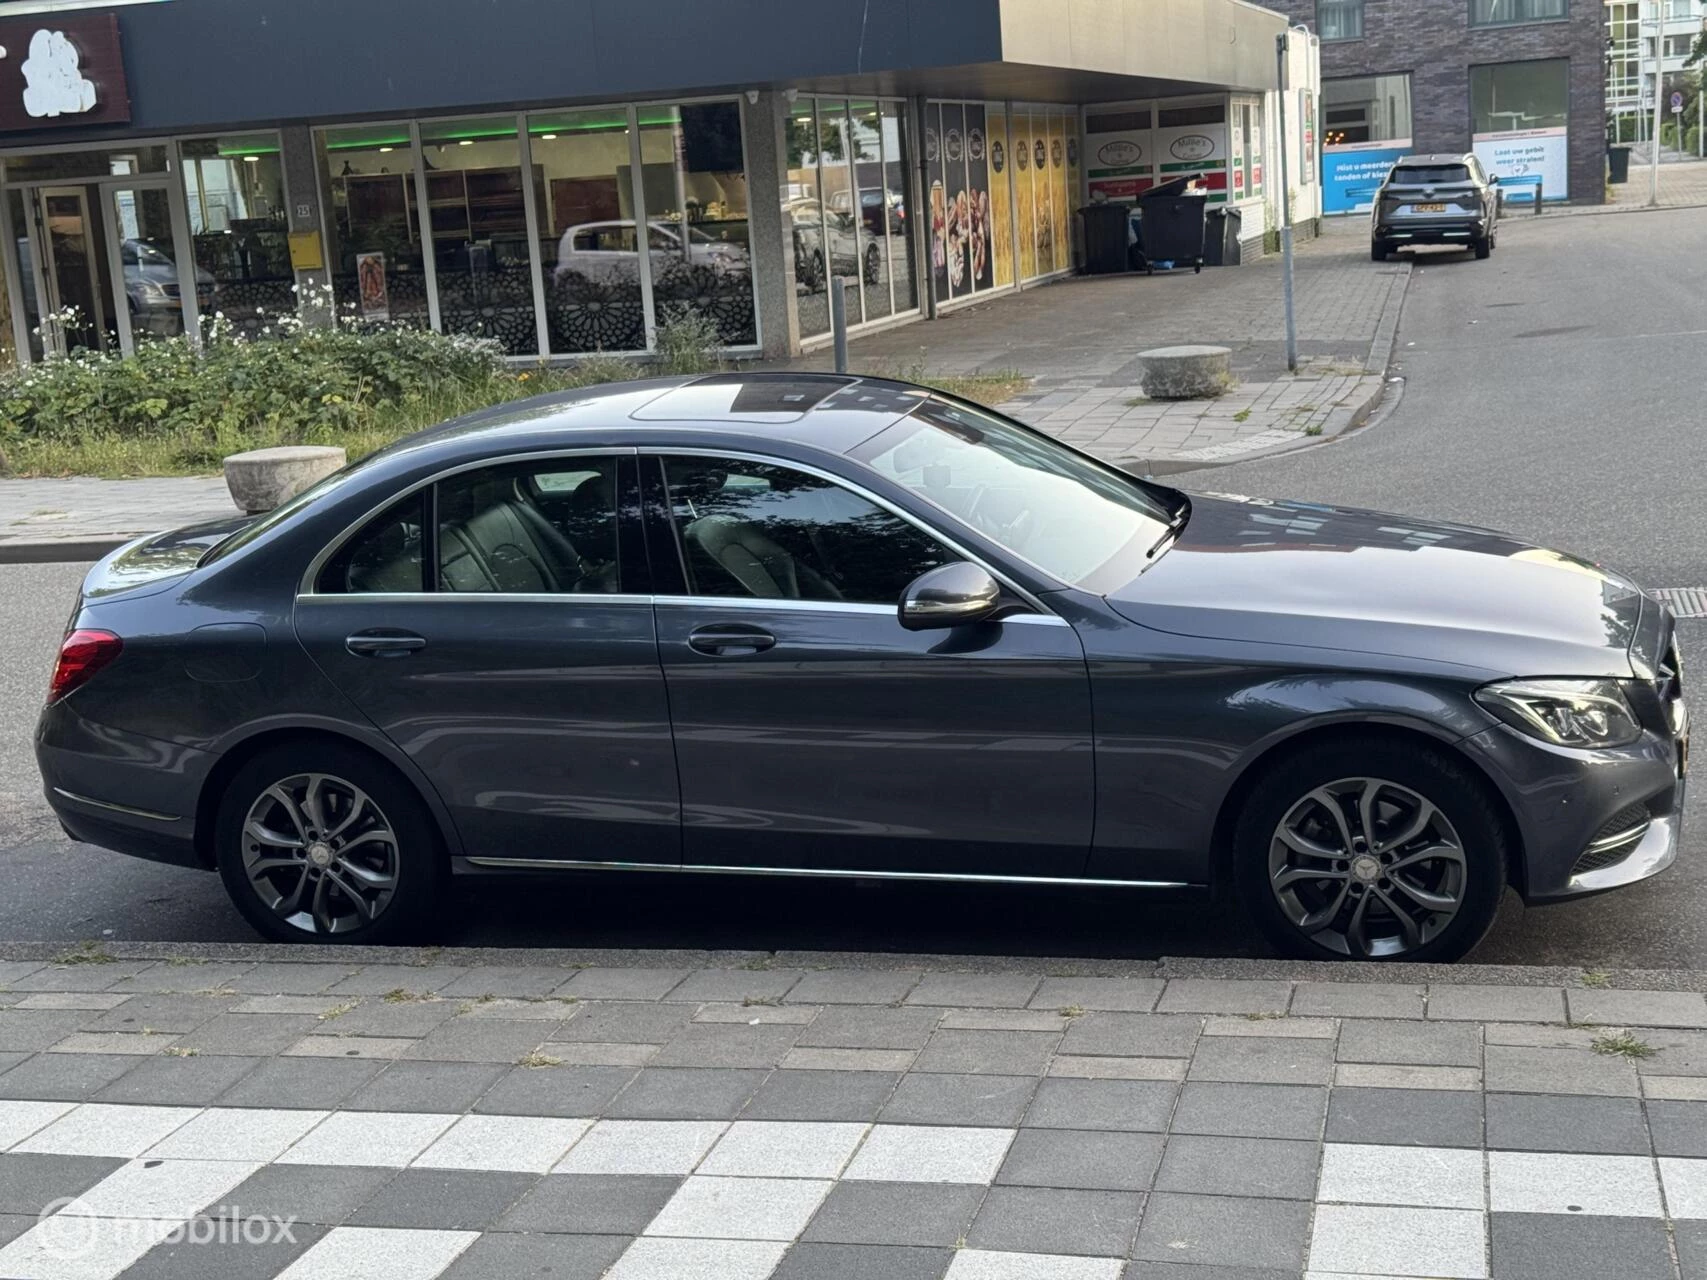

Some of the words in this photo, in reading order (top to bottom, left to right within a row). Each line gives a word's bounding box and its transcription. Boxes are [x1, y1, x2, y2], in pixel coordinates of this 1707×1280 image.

[1494, 148, 1510, 156] Laat
[1525, 145, 1544, 154] gebit
[1516, 155, 1544, 164] stralen!
[1336, 163, 1353, 172] Mist
[1360, 160, 1394, 169] meerder
[1362, 171, 1371, 179] of
[1372, 170, 1389, 179] kiez
